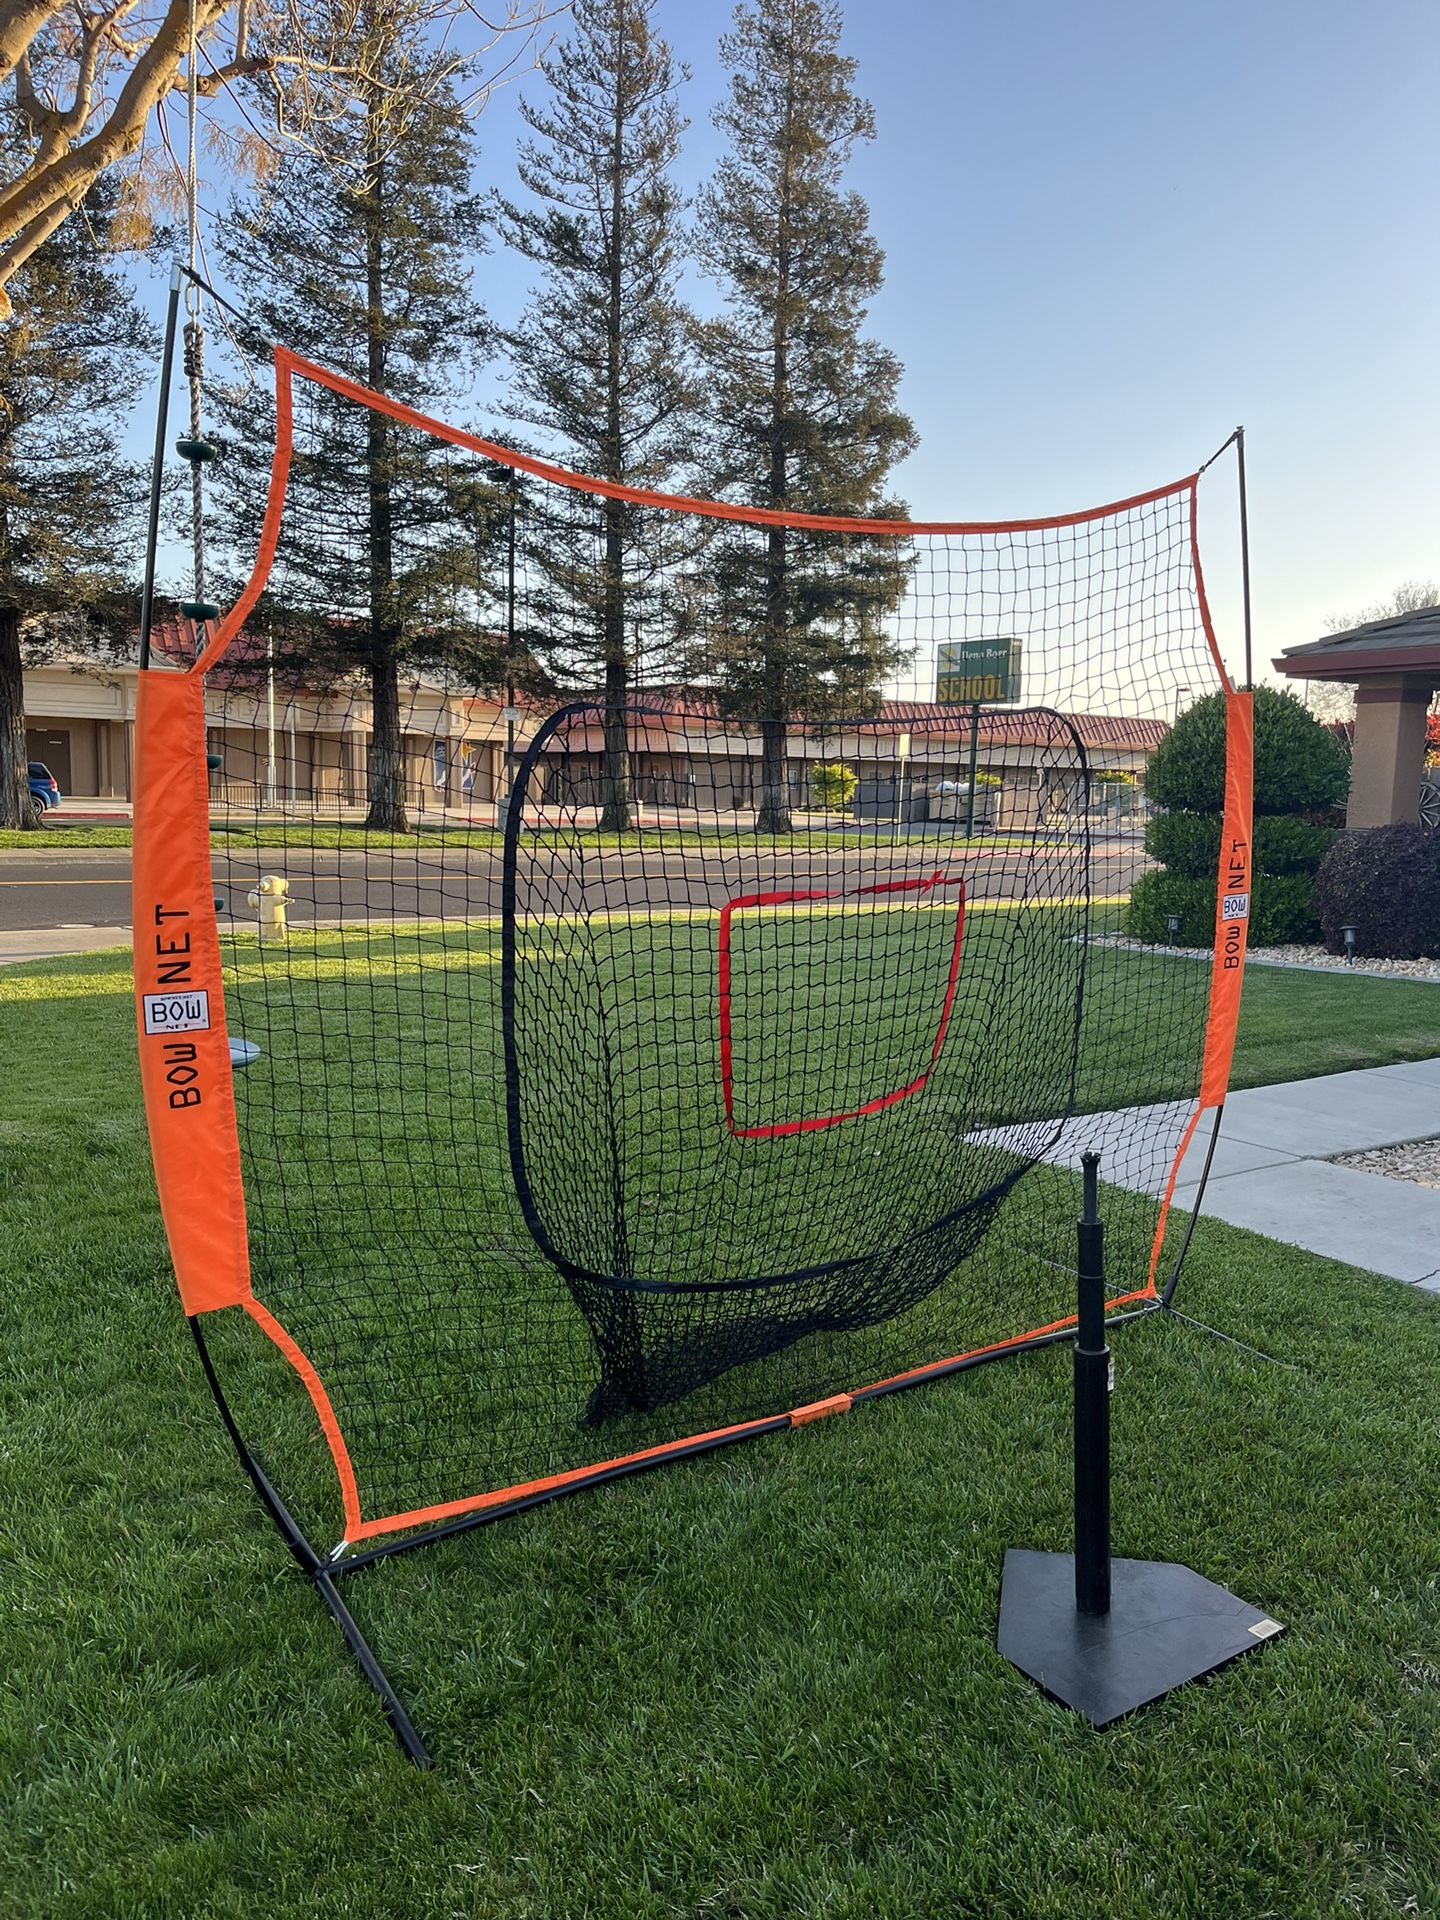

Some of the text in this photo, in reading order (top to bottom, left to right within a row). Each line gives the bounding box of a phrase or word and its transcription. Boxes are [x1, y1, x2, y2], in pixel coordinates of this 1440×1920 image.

[986, 648, 1007, 659] Boer
[938, 674, 1005, 702] SCHOOL
[1227, 839, 1247, 889] NET
[1224, 898, 1246, 914] BOW
[1223, 926, 1241, 970] BOW
[151, 999, 201, 1023] BOW
[155, 904, 202, 1110] BOW NET
